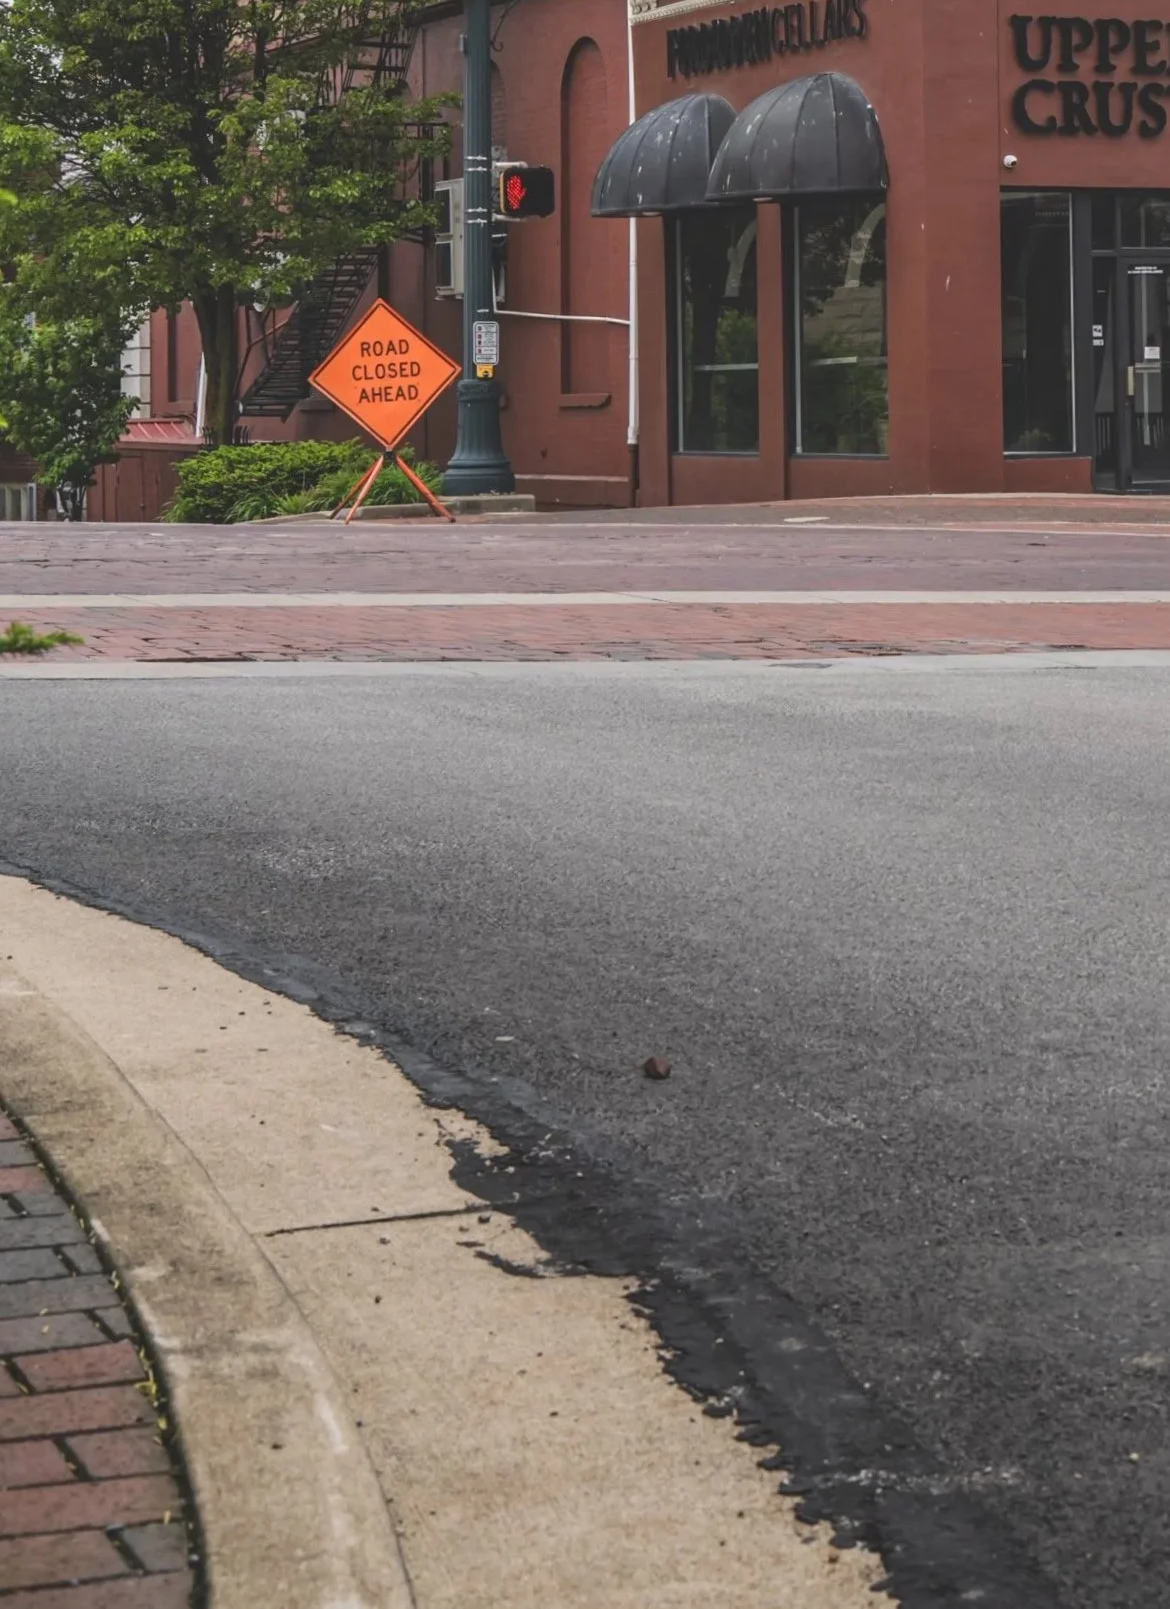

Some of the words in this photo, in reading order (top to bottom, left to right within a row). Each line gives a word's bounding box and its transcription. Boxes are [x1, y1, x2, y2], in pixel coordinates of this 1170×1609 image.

[360, 339, 409, 358] ROAD
[352, 361, 421, 381] CLOSED
[358, 384, 419, 404] AHEAD
